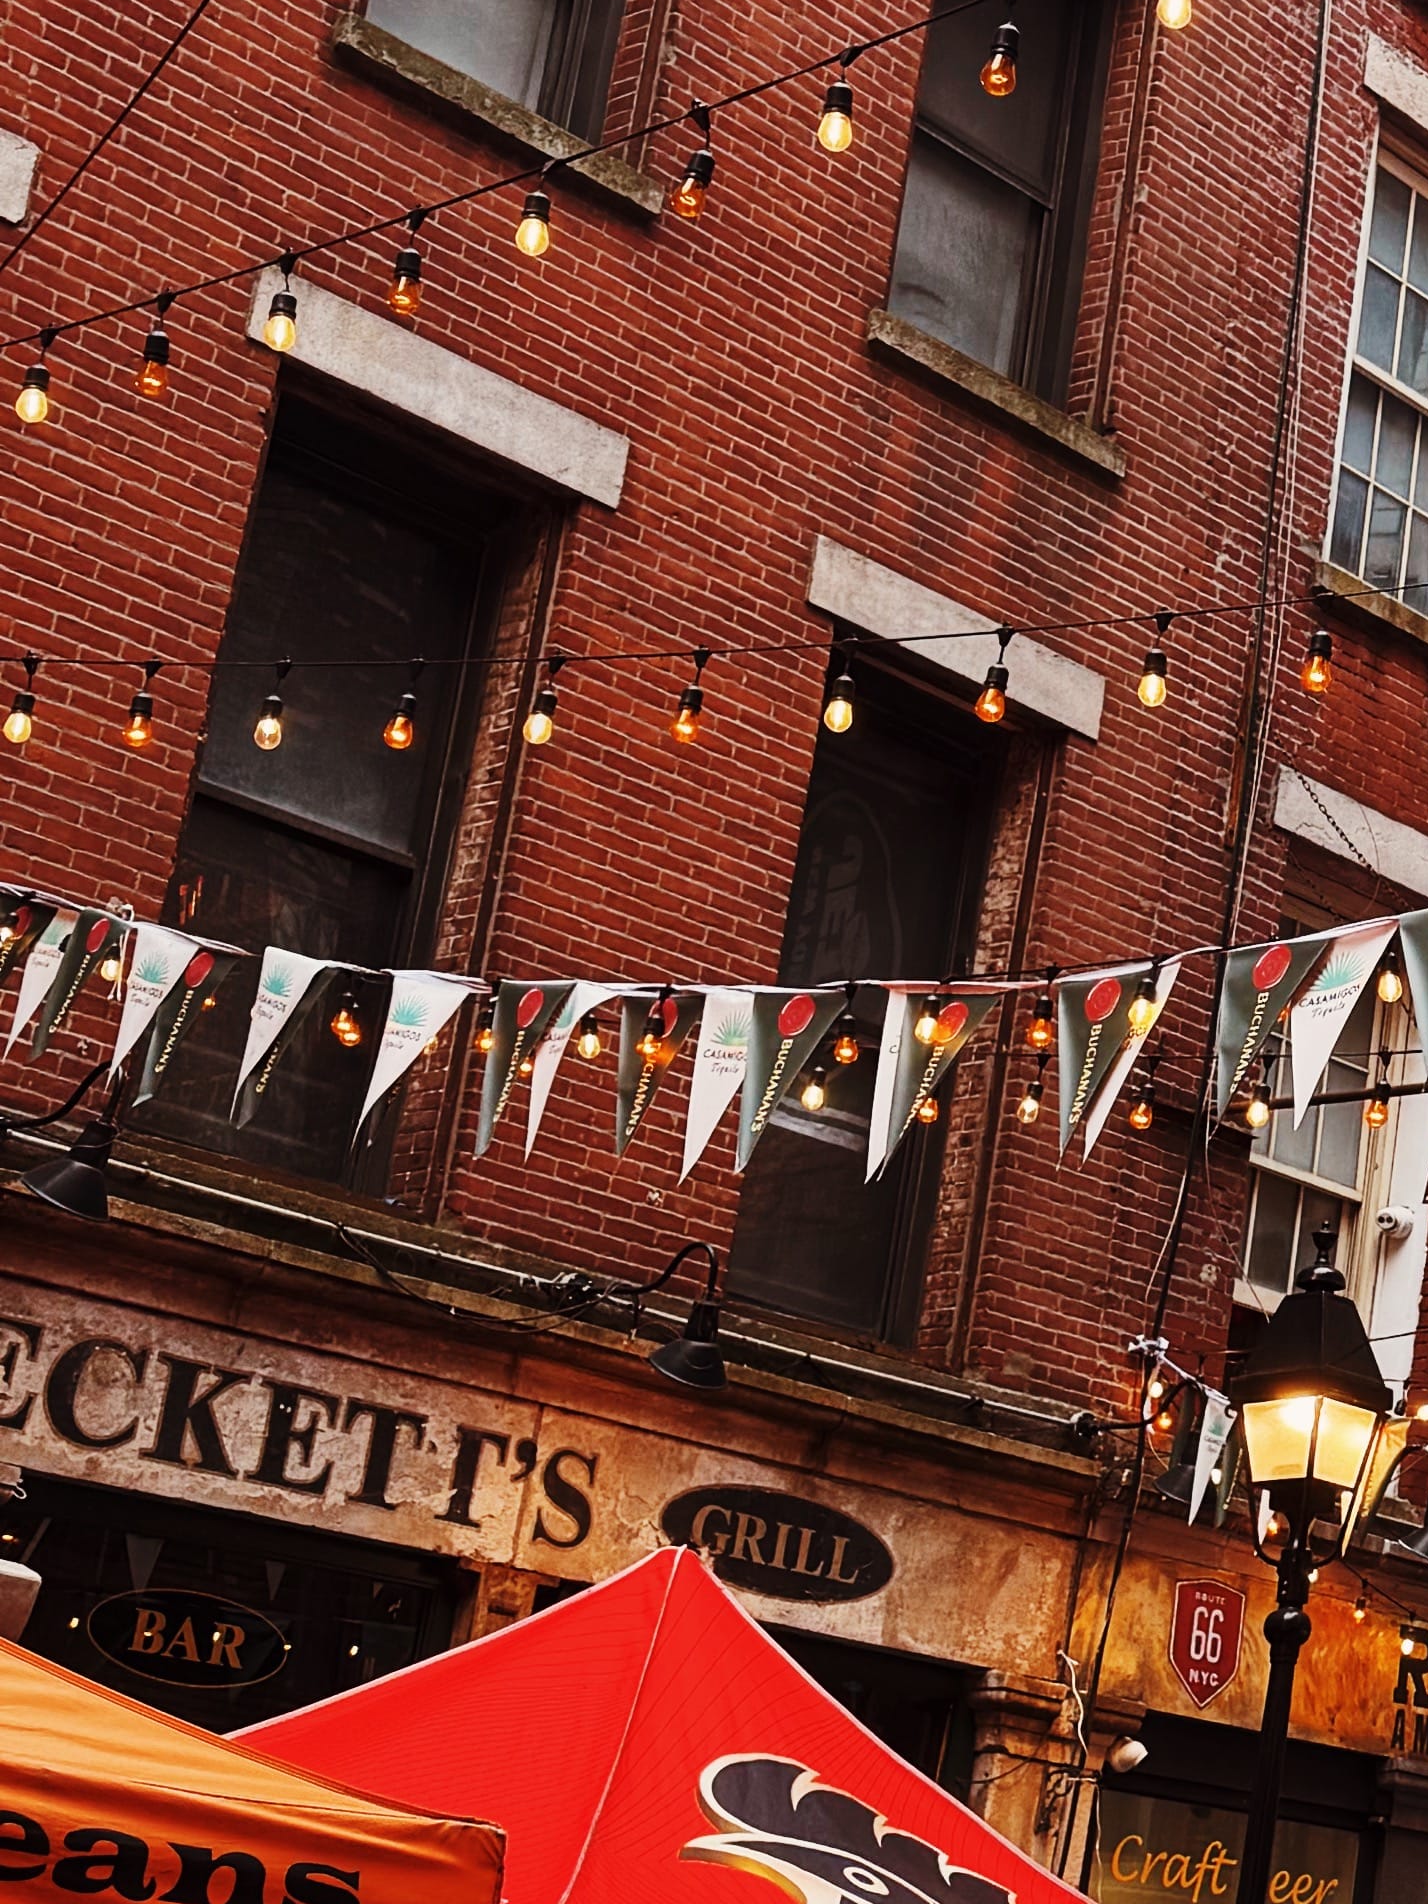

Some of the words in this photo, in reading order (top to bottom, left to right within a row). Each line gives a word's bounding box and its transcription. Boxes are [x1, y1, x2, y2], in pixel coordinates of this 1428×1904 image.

[689, 1500, 861, 1585] GRILL
[131, 1610, 244, 1670] BAR
[1190, 1606, 1225, 1663] 66
[1110, 1833, 1236, 1903] Craft
